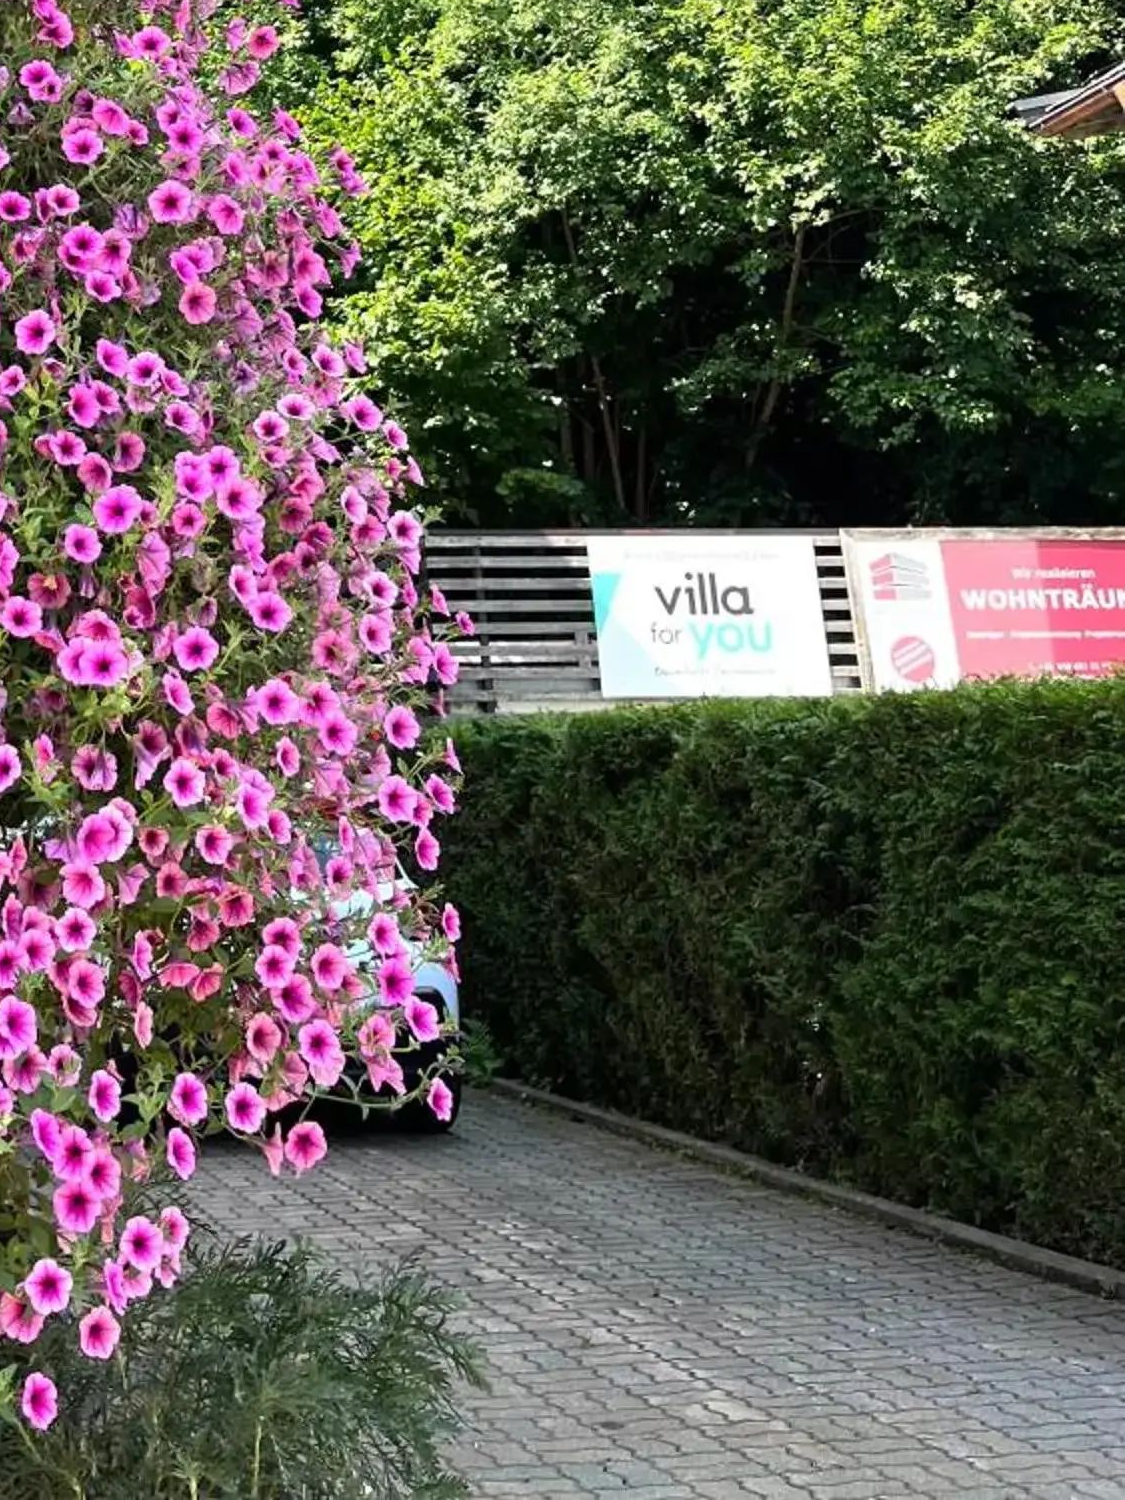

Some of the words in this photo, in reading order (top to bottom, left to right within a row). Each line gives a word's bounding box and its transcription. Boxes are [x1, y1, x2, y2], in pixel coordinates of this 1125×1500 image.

[654, 572, 754, 615] villa
[650, 622, 683, 645] for
[688, 620, 774, 661] you
